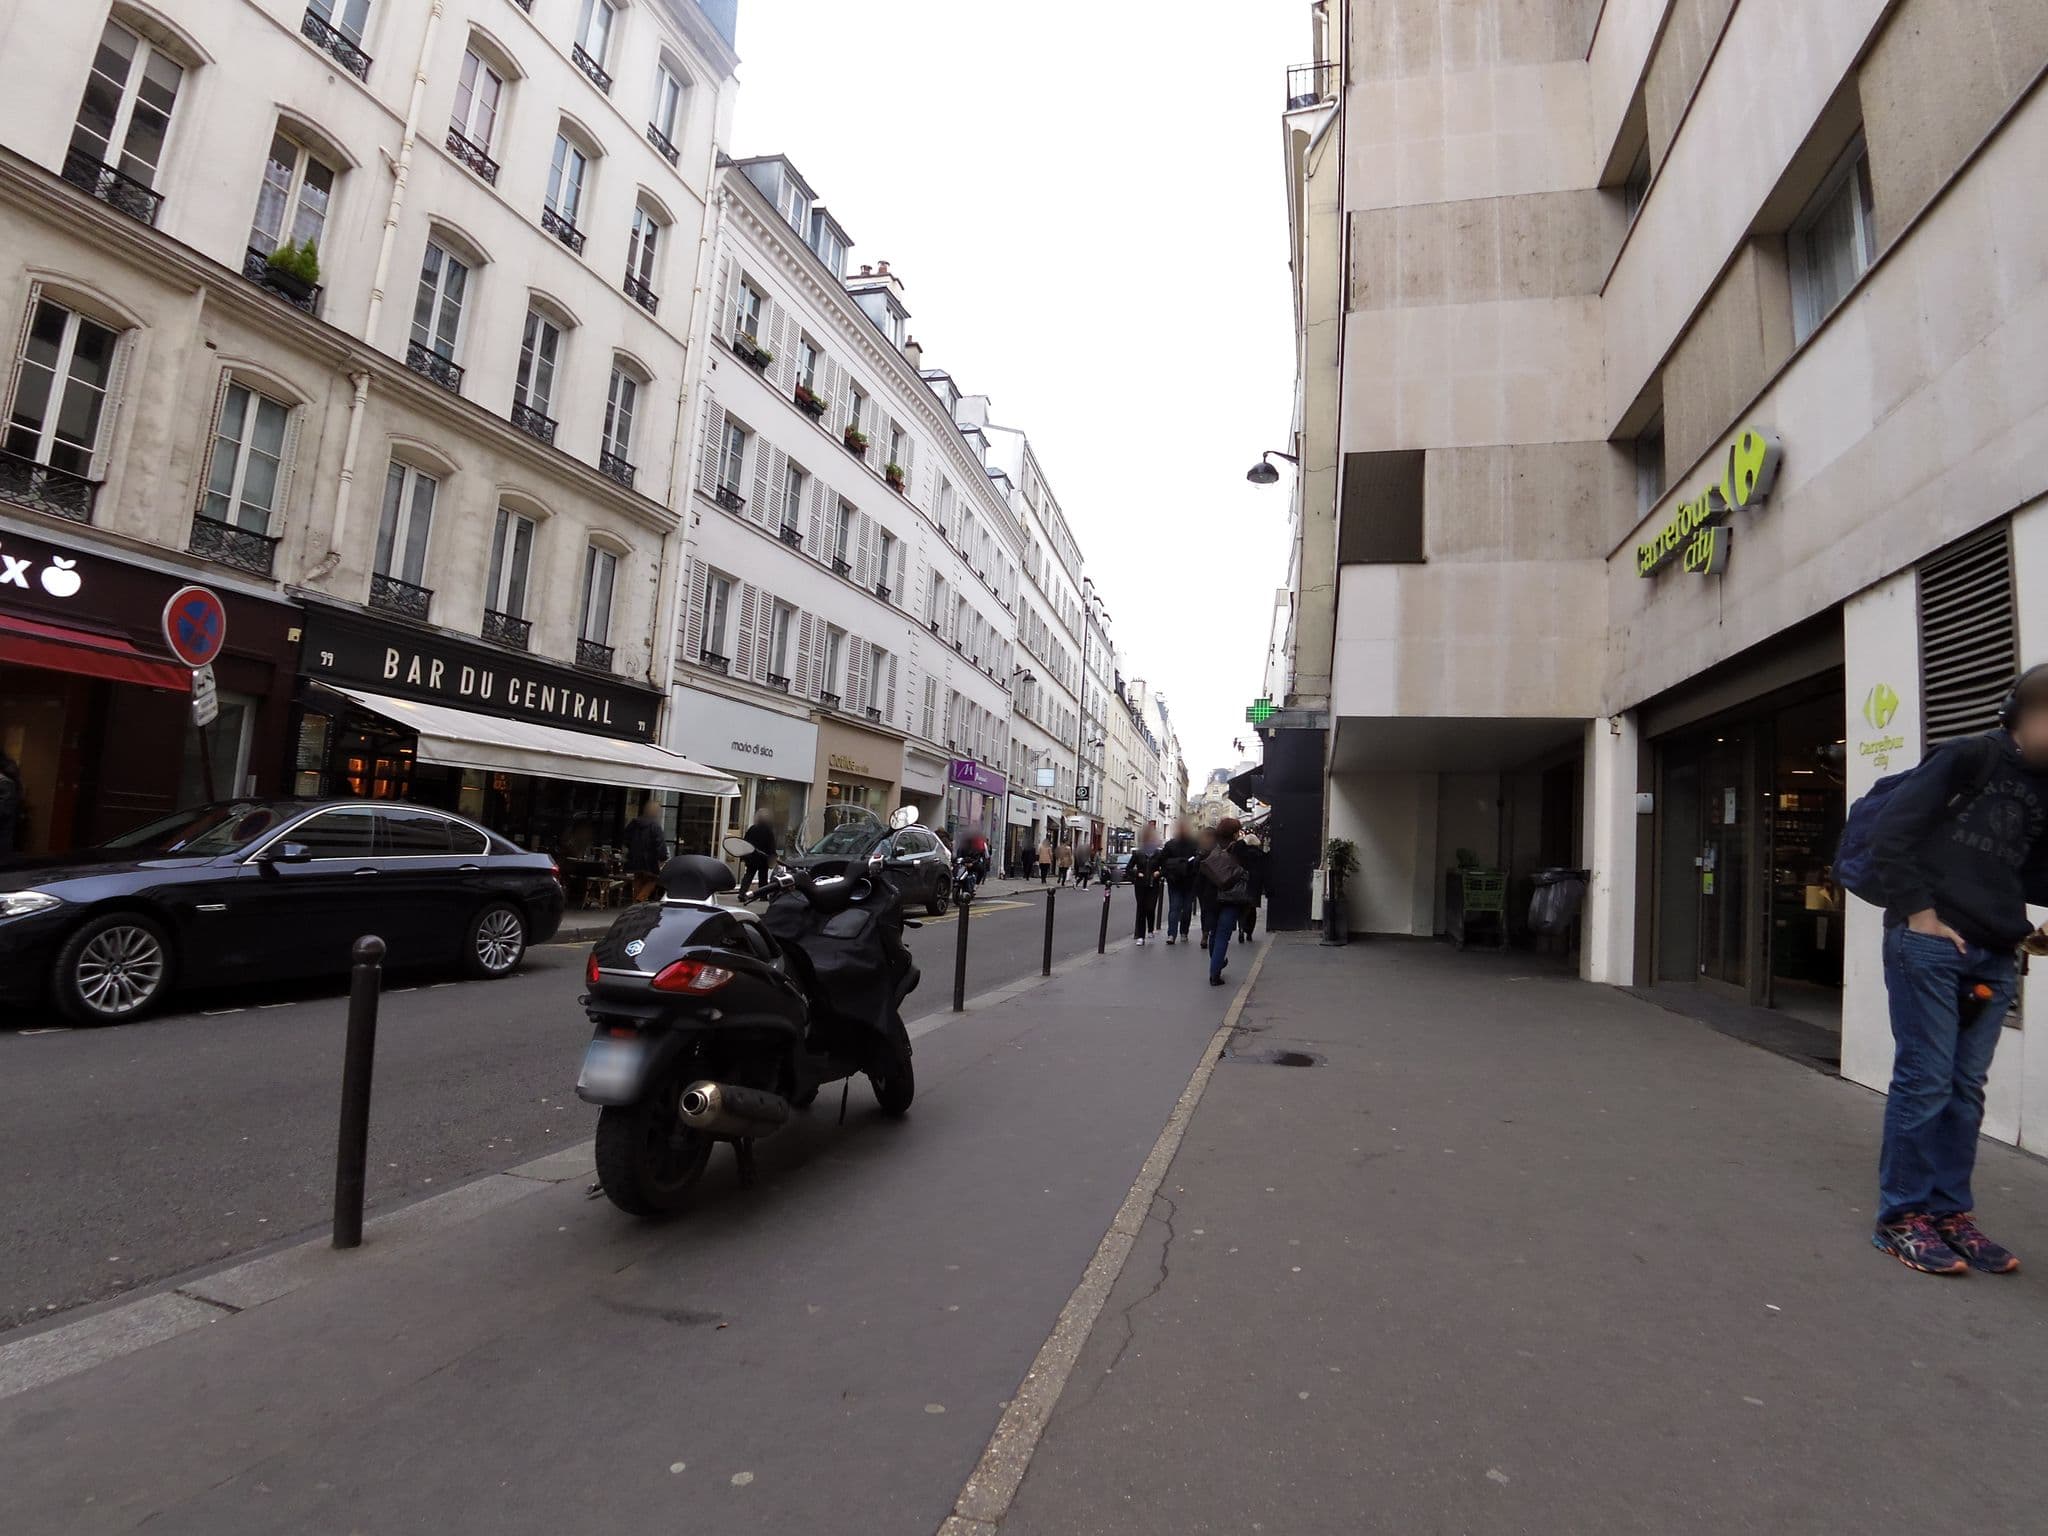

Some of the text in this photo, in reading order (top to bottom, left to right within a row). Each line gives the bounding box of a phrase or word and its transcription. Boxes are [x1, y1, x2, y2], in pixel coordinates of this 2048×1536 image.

[1684, 527, 1715, 575] city
[384, 648, 612, 724] BAR DU CENTRAL
[731, 741, 752, 753] mario
[1860, 735, 1904, 755] Carrefour
[1873, 753, 1889, 770] city
